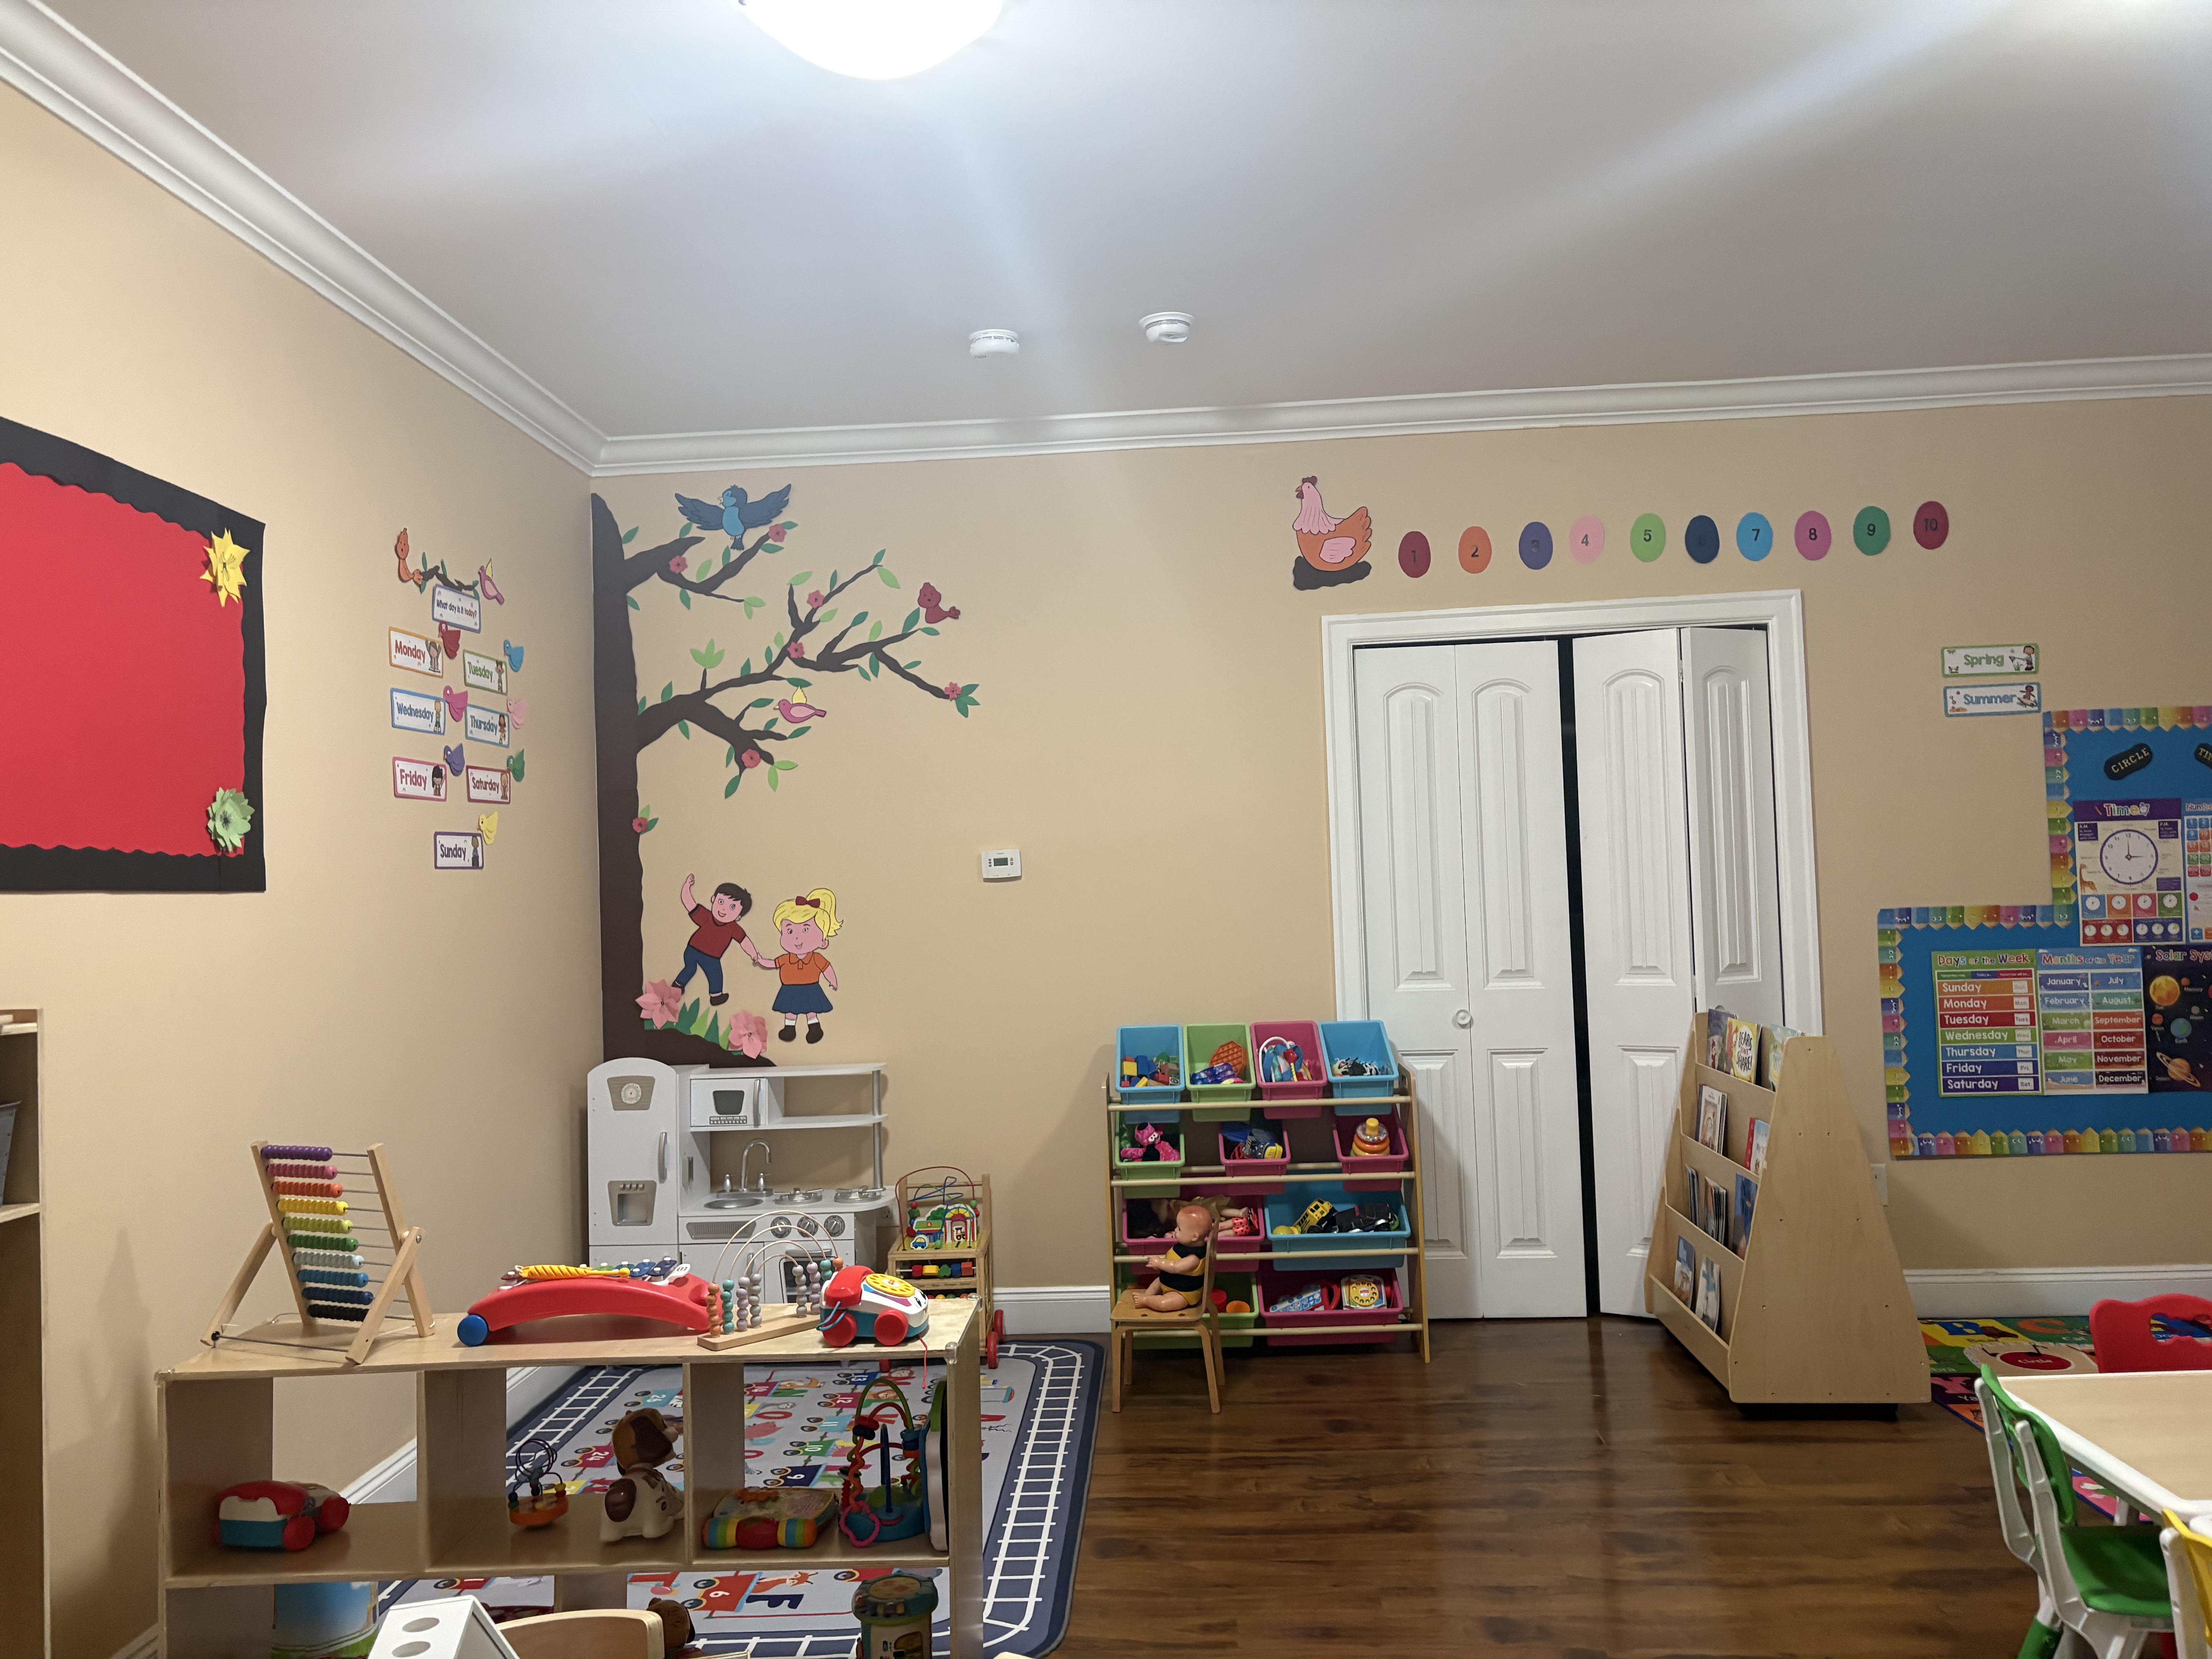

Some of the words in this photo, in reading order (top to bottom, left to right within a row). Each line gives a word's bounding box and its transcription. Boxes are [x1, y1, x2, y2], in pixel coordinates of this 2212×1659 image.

[1867, 523, 1876, 536] 9
[1923, 518, 1938, 532] 10
[1580, 534, 1589, 547] 4
[1643, 529, 1652, 542] 5
[1751, 528, 1761, 541] 7
[1808, 527, 1818, 541] 8
[1471, 545, 1479, 558] 2
[1531, 539, 1540, 553] 3
[1411, 550, 1417, 563] 1
[436, 598, 448, 610] What
[448, 602, 457, 614] day
[464, 606, 477, 619] today?
[395, 639, 426, 663] Monday
[1963, 653, 2004, 668] Spring
[467, 661, 493, 683] Tuesday
[1963, 694, 2017, 705] Summer
[396, 702, 434, 723] Wednesday
[470, 715, 498, 735] Thursday
[2111, 748, 2150, 773] CIRCLE
[400, 768, 427, 790] Friday
[472, 778, 500, 794] Saturday
[2104, 803, 2140, 816] Time
[440, 843, 466, 861] Sunday
[1938, 955, 1966, 967] Days
[1982, 956, 1996, 965] the
[1998, 954, 2030, 963] Week
[2042, 954, 2084, 965] Months
[2107, 953, 2135, 964] Year
[2155, 949, 2187, 961] Solar
[2190, 949, 2212, 963] Sys
[2047, 977, 2081, 986] January
[2108, 976, 2124, 985] July
[1942, 982, 1982, 993] Sunday
[1943, 998, 1987, 1010] Monday
[2045, 996, 2085, 1005] February
[2102, 996, 2131, 1005] August
[1944, 1014, 1989, 1025] Tuesday
[2095, 1016, 2142, 1025] September
[1738, 1031, 1753, 1051] BEARS
[1945, 1030, 2008, 1041] Wednesday
[2057, 1035, 2077, 1045] April
[1946, 1046, 1996, 1058] Thursday
[1736, 1049, 1753, 1072] SHARE!
[2097, 1055, 2142, 1063] November
[1946, 1063, 1982, 1074] Friday
[1947, 1079, 1999, 1090] Saturday
[2099, 1074, 2142, 1083] December
[1936, 1321, 1984, 1336] B
[2018, 1319, 2066, 1334] C
[646, 1394, 666, 1403] 26
[586, 1451, 610, 1462] 24
[709, 1590, 731, 1599] 6
[745, 1593, 805, 1610] F
